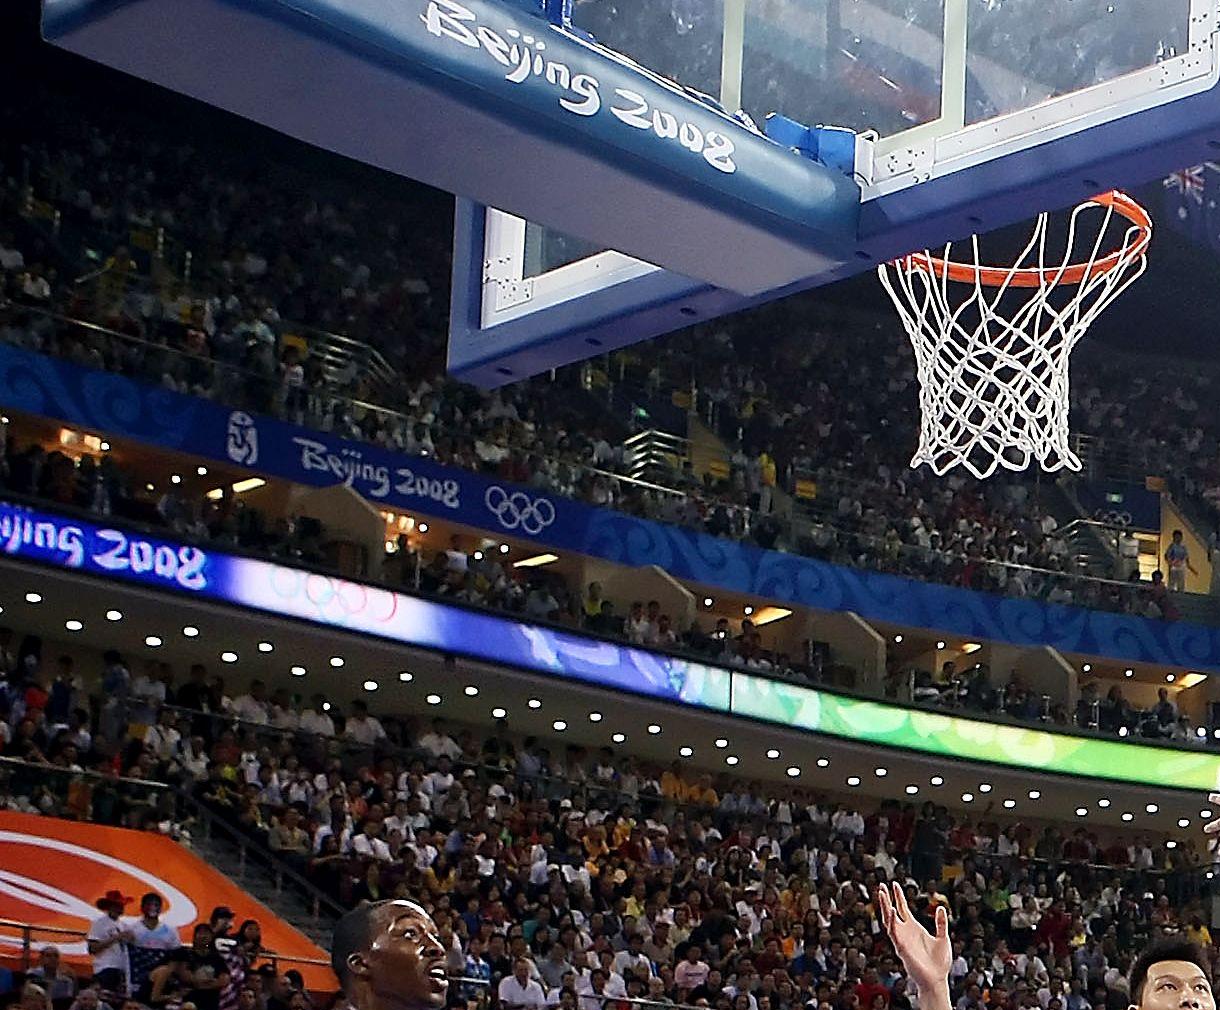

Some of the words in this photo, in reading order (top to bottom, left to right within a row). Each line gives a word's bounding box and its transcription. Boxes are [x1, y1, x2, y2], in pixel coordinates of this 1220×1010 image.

[420, 0, 601, 116] Beijing
[610, 88, 736, 173] 2008
[292, 437, 390, 497] Beijing
[396, 469, 459, 509] 2008
[0, 502, 83, 567] ijing
[92, 528, 207, 590] 2008
